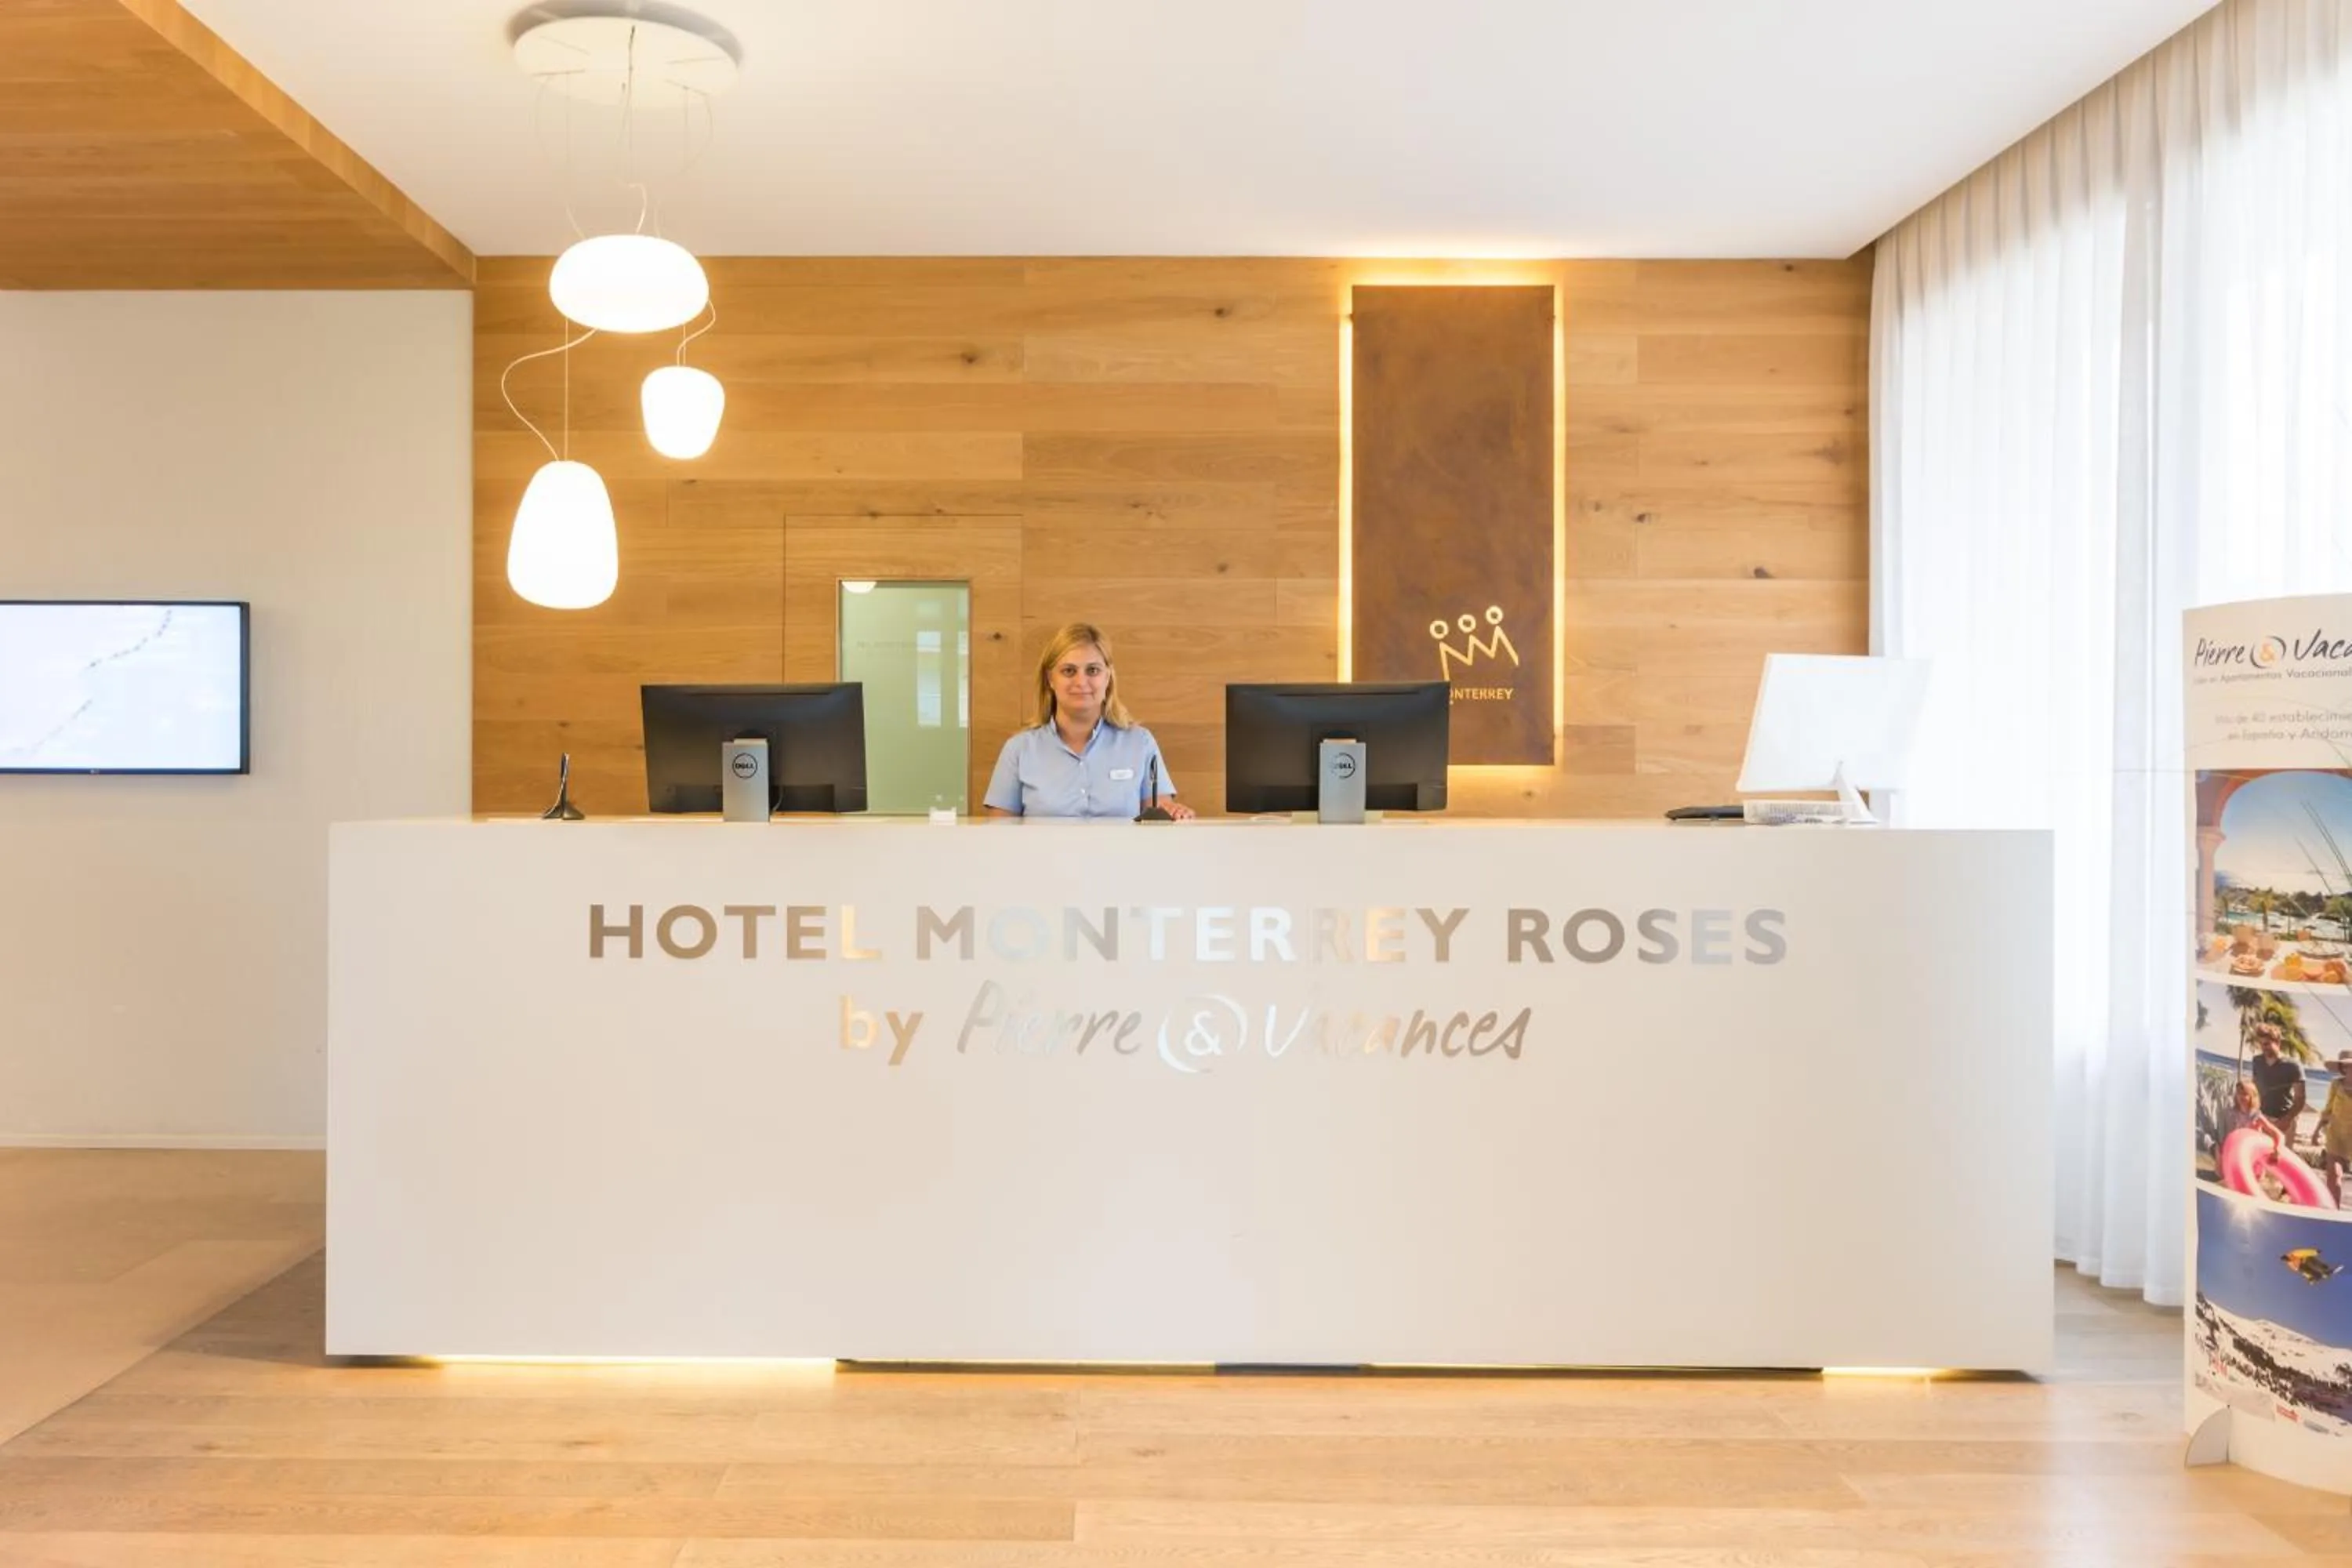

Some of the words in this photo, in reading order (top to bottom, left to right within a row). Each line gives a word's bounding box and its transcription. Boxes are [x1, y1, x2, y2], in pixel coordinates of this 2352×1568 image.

[2194, 637, 2245, 666] Pierre
[1450, 688, 1514, 700] NTERREY
[589, 904, 883, 960] HOTEL
[916, 904, 1470, 965] MONTERREY
[1507, 908, 1788, 966] ROSES
[837, 993, 926, 1067] by
[956, 978, 1145, 1057] Pierre
[1264, 982, 1534, 1060] Vacances
